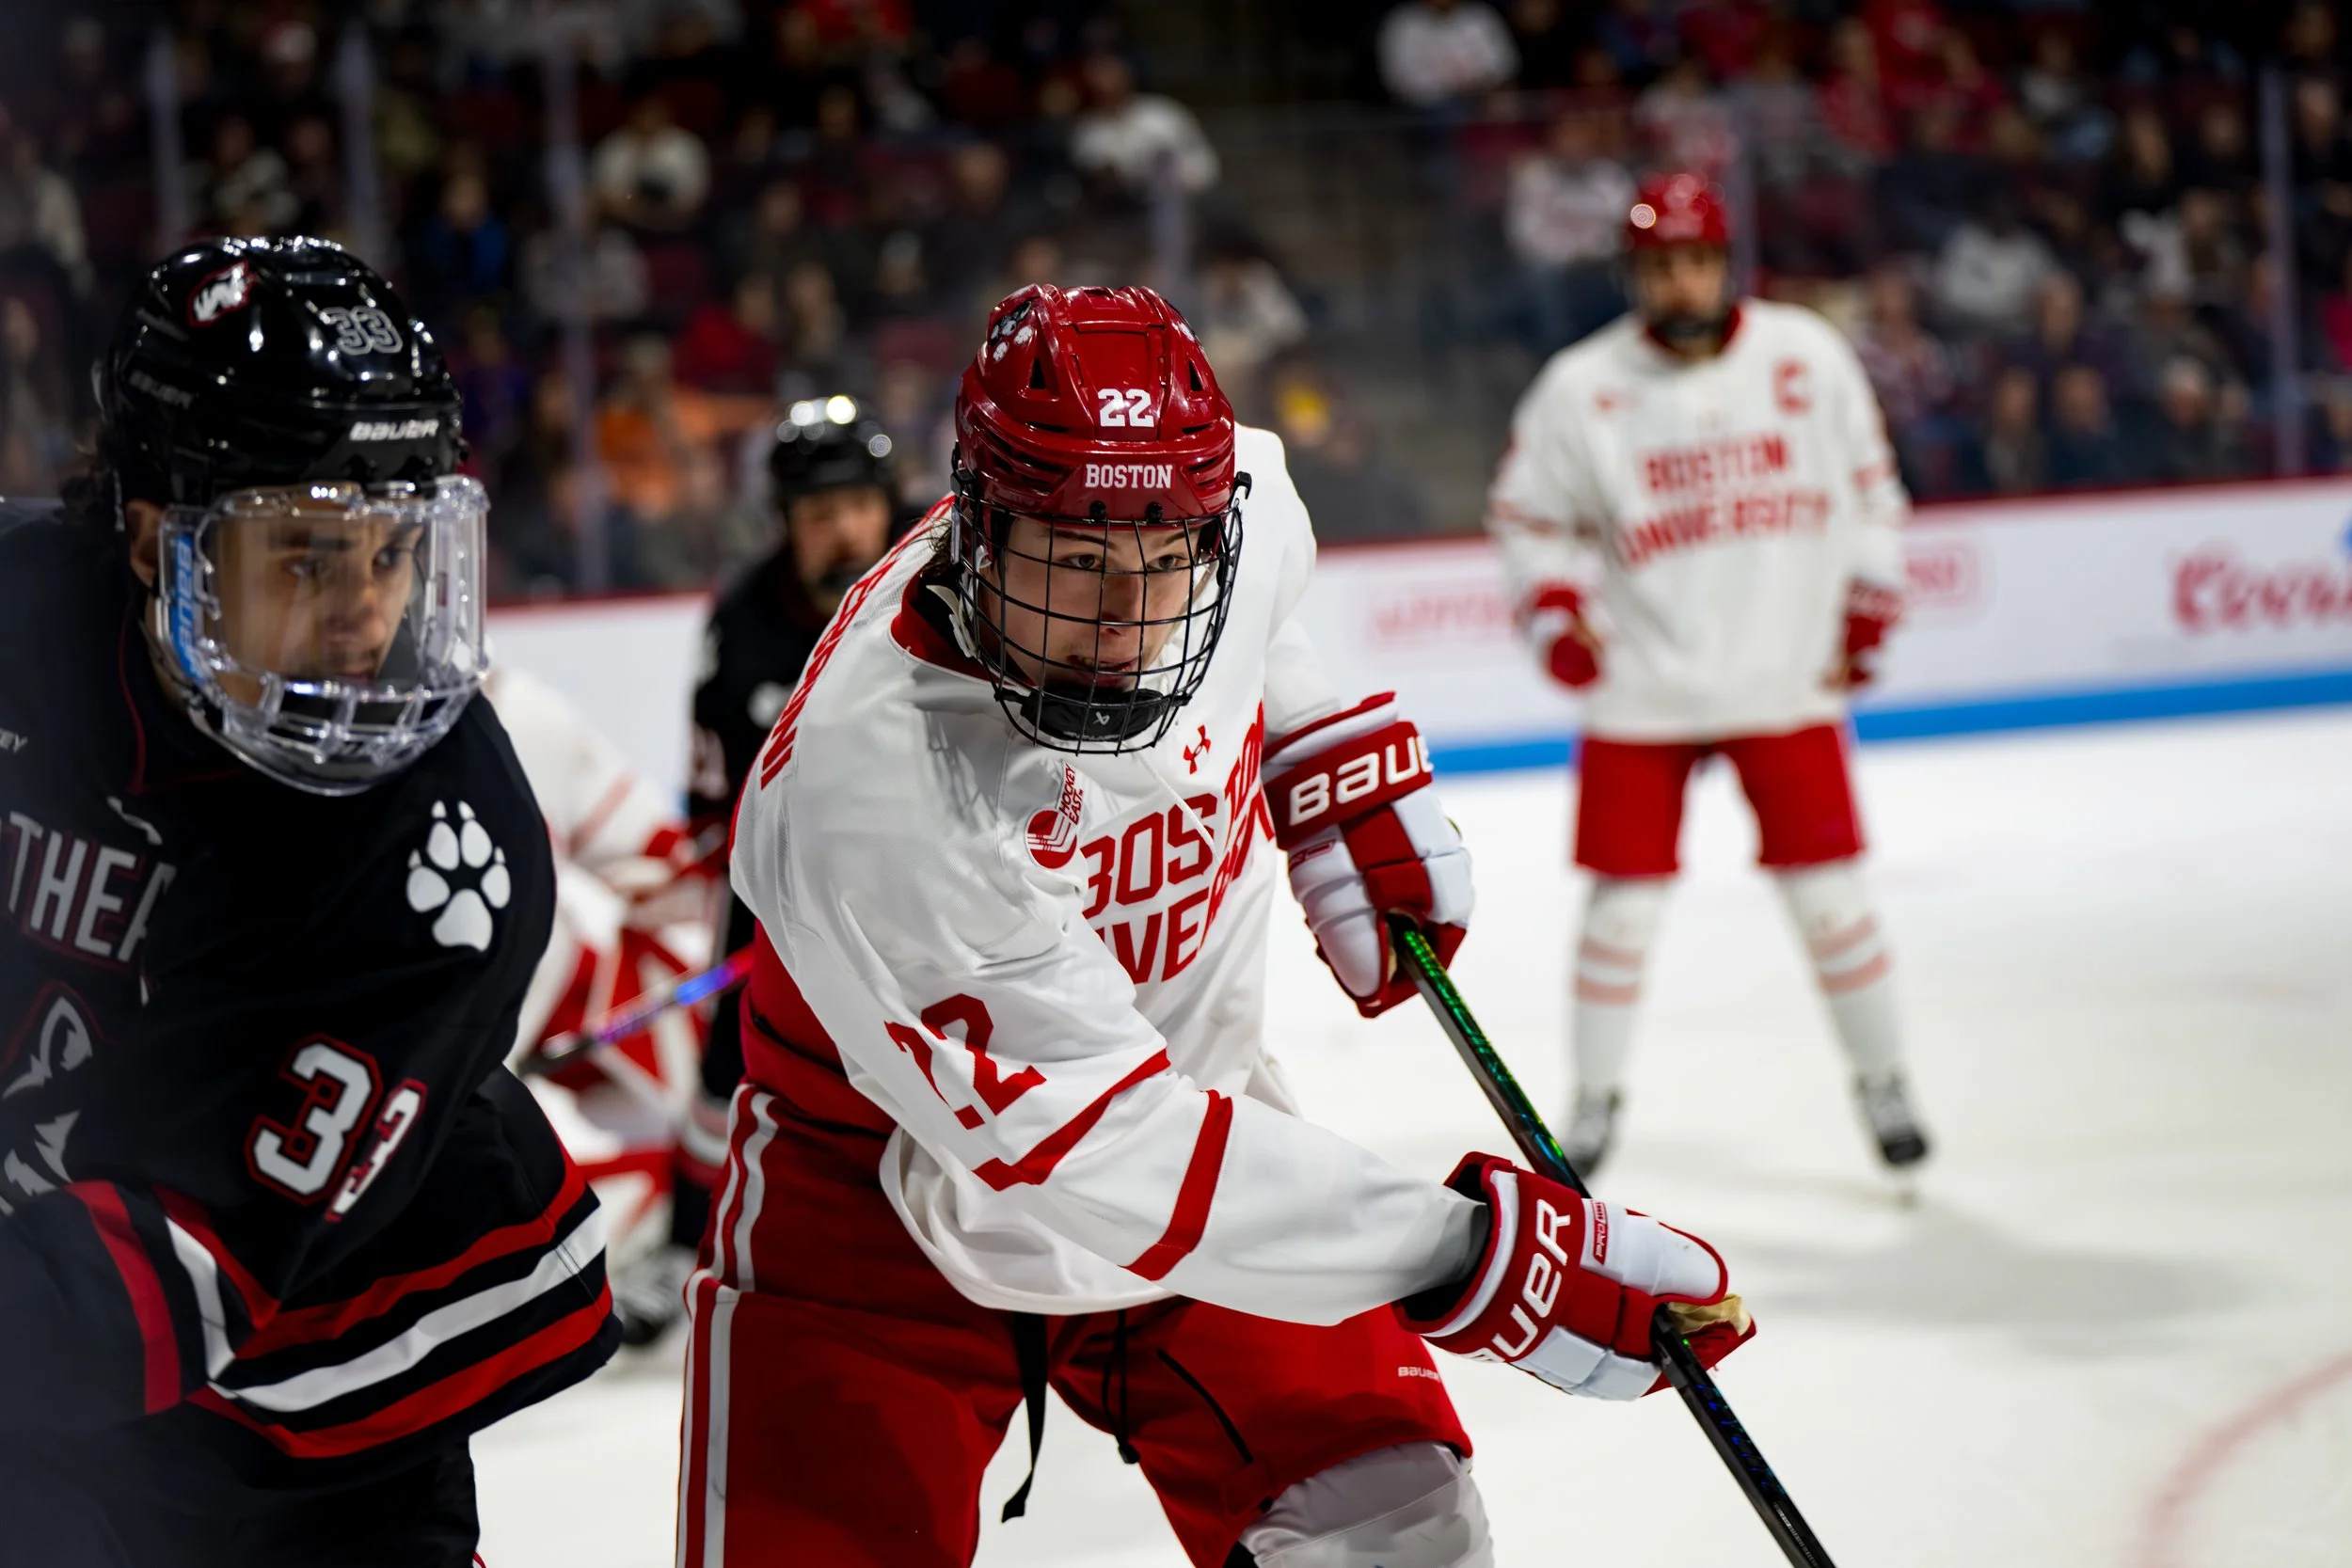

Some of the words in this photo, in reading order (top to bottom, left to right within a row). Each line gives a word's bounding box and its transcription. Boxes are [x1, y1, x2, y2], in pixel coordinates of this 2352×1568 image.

[321, 306, 404, 356] 33
[1097, 388, 1155, 429] 22
[1772, 357, 1811, 415] C
[349, 420, 439, 441] BAUER
[1085, 464, 1173, 489] BOSTON
[1643, 433, 1789, 493] BOSTON
[1058, 763, 1075, 817] HOCKEY
[883, 992, 1047, 1131] 22
[248, 1037, 424, 1219] 33
